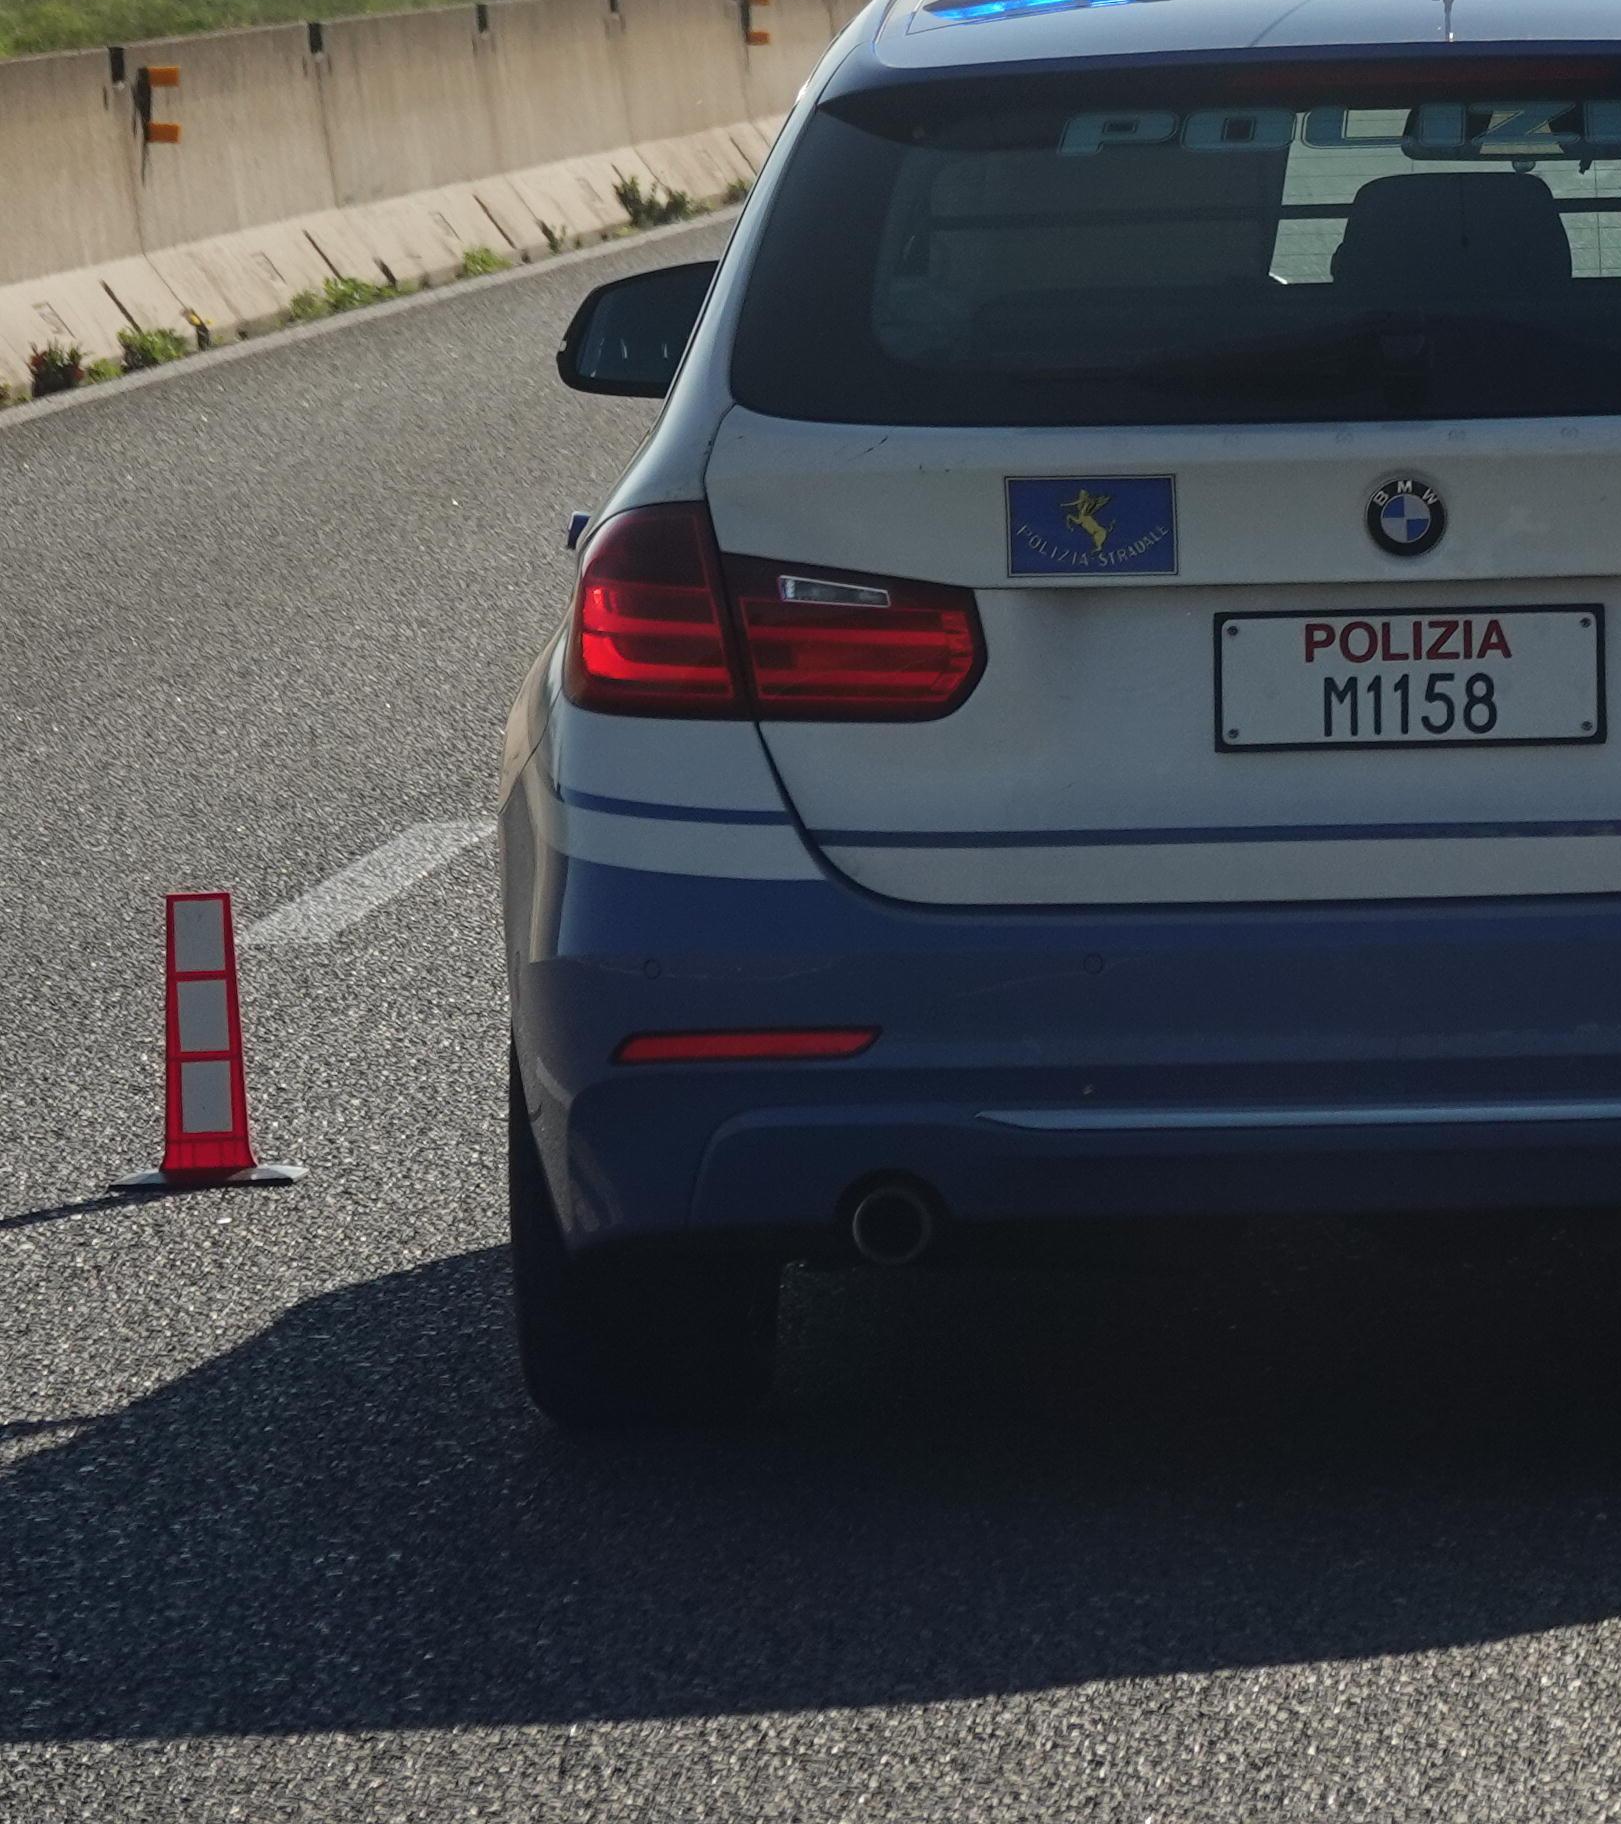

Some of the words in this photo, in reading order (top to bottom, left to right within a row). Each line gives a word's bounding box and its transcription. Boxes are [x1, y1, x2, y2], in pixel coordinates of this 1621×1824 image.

[1372, 480, 1439, 506] BMW
[1016, 523, 1089, 567] POLIZIA
[1305, 619, 1512, 663] POLIZIA
[1323, 672, 1498, 737] M1158
